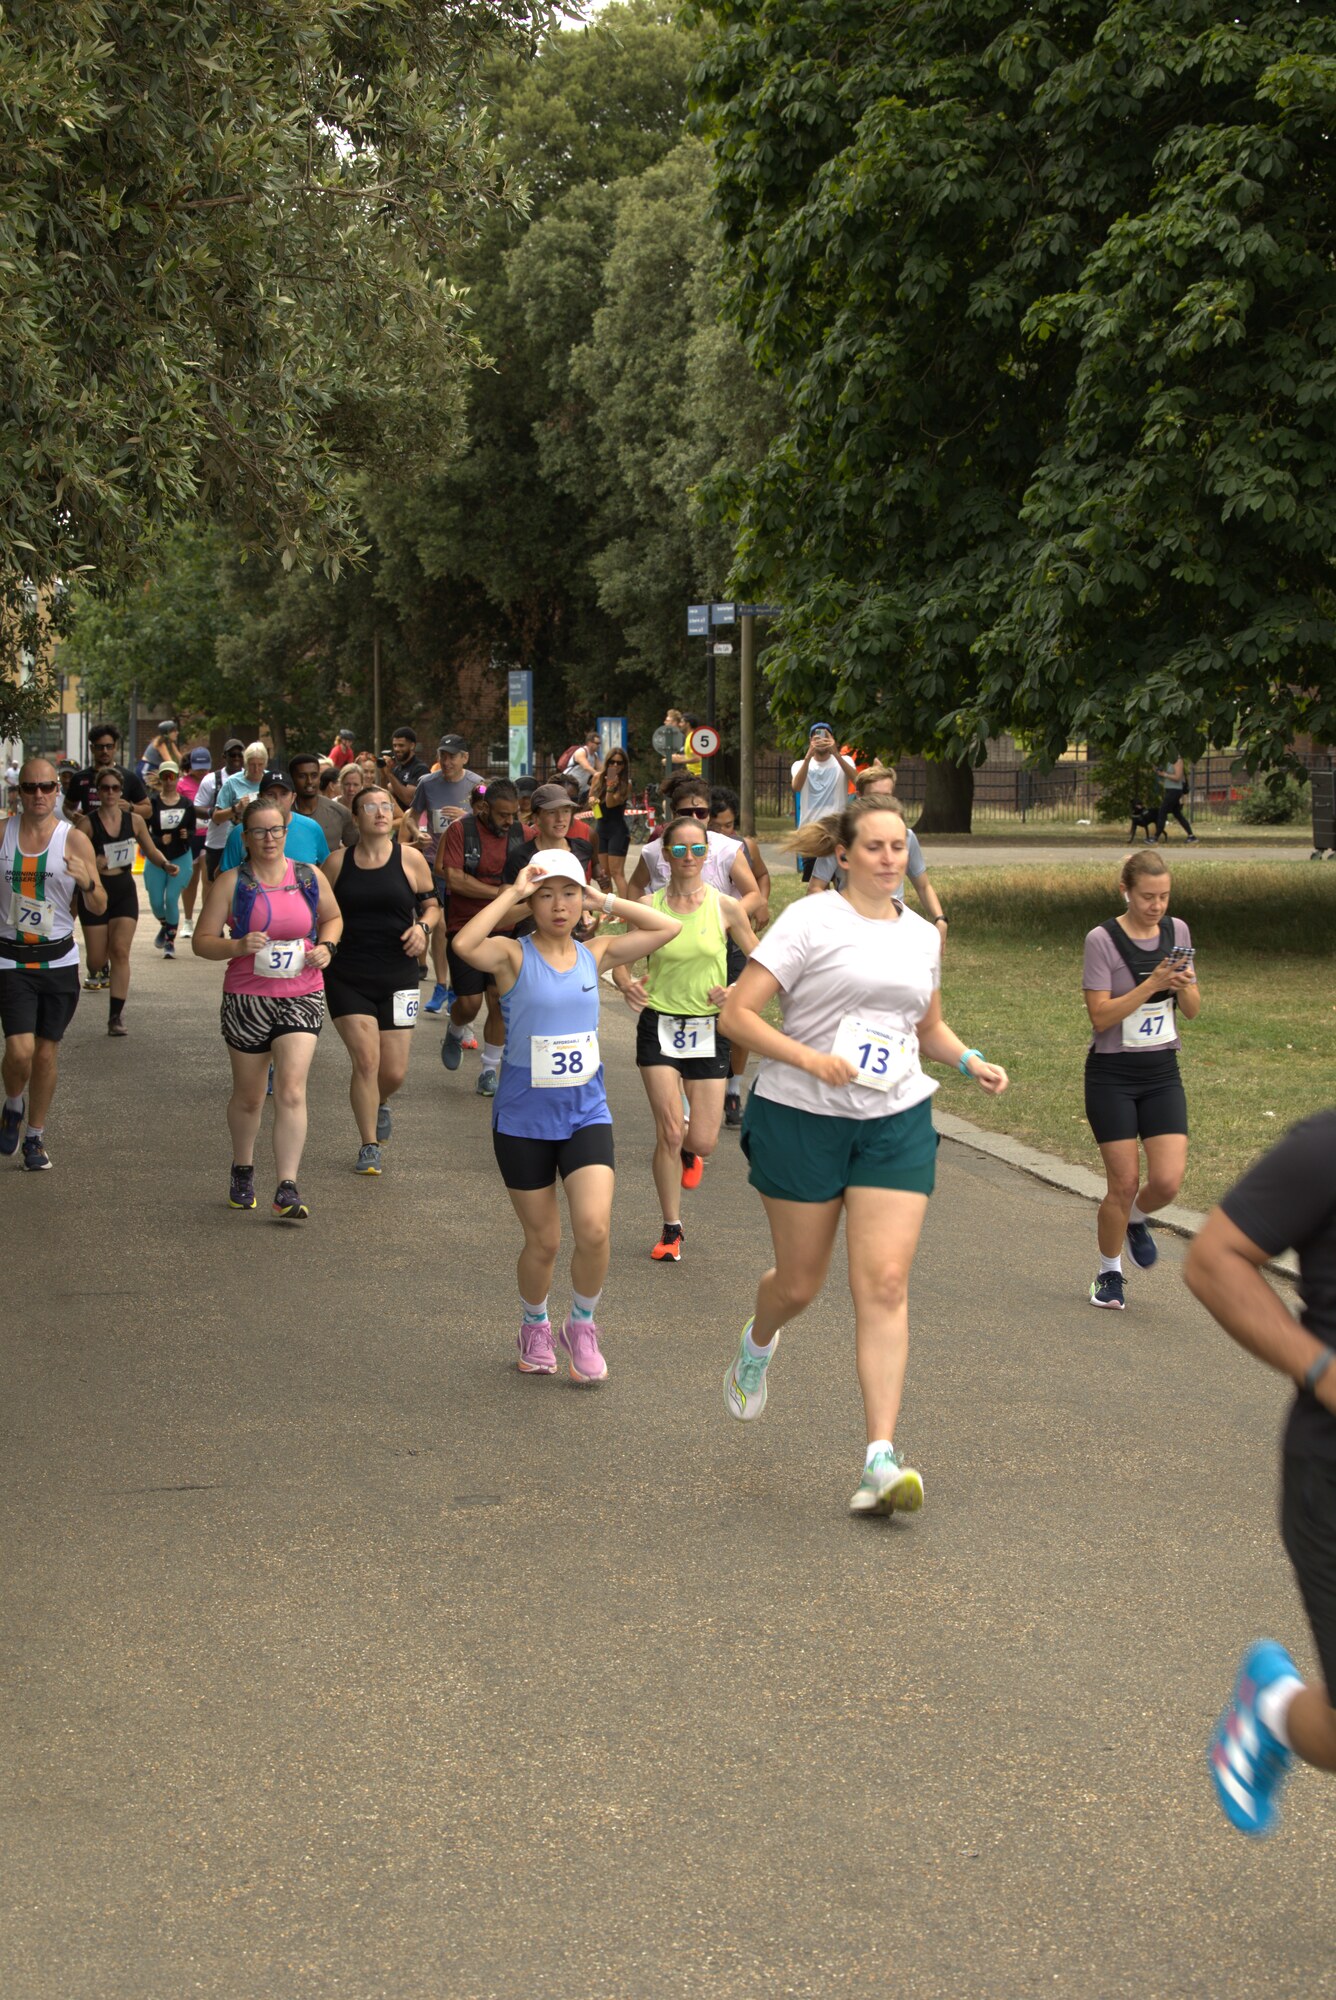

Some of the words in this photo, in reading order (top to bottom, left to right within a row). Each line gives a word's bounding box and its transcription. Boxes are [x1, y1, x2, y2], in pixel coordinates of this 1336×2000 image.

[700, 735, 709, 748] 5
[168, 815, 180, 824] 32
[114, 849, 130, 861] 77
[5, 870, 54, 878] MORNINGTON
[19, 907, 42, 926] 79
[269, 951, 293, 969] 37
[406, 1000, 419, 1017] 69
[1138, 1015, 1165, 1036] 47
[673, 1031, 697, 1049] 81
[551, 1050, 583, 1075] 38
[858, 1043, 890, 1075] 13
